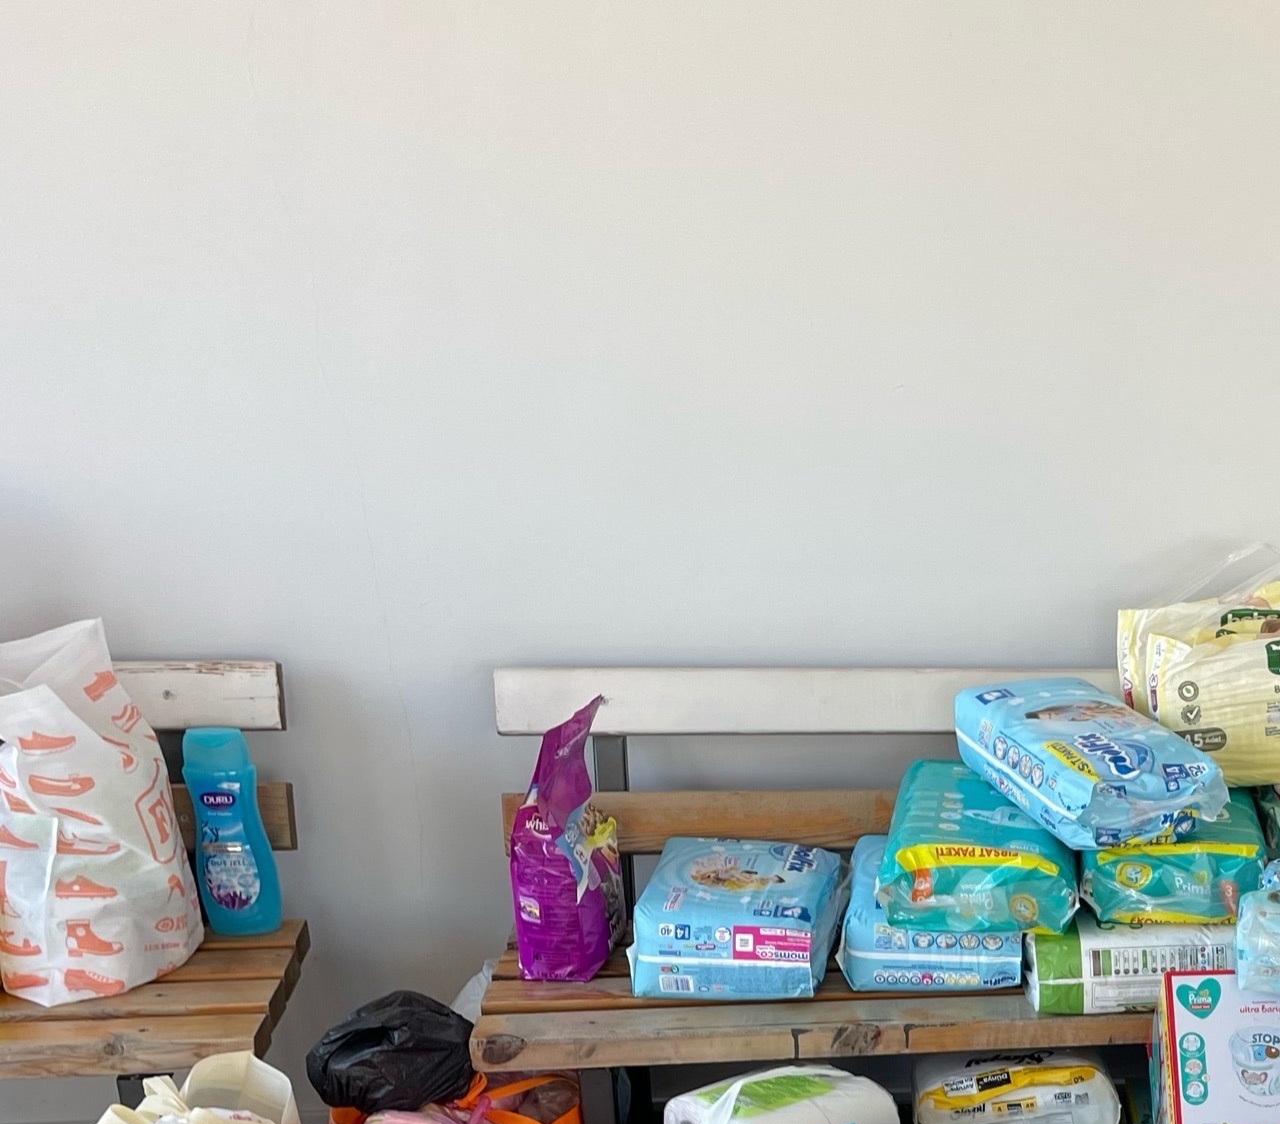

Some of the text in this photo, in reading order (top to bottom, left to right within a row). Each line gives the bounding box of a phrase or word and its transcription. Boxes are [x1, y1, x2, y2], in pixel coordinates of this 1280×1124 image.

[203, 795, 234, 805] DURU
[935, 846, 976, 860] PAKETİ
[1224, 884, 1233, 896] 3
[1187, 990, 1213, 1004] Prima
[1239, 1004, 1259, 1014] ultra
[1252, 1033, 1280, 1046] STOP
